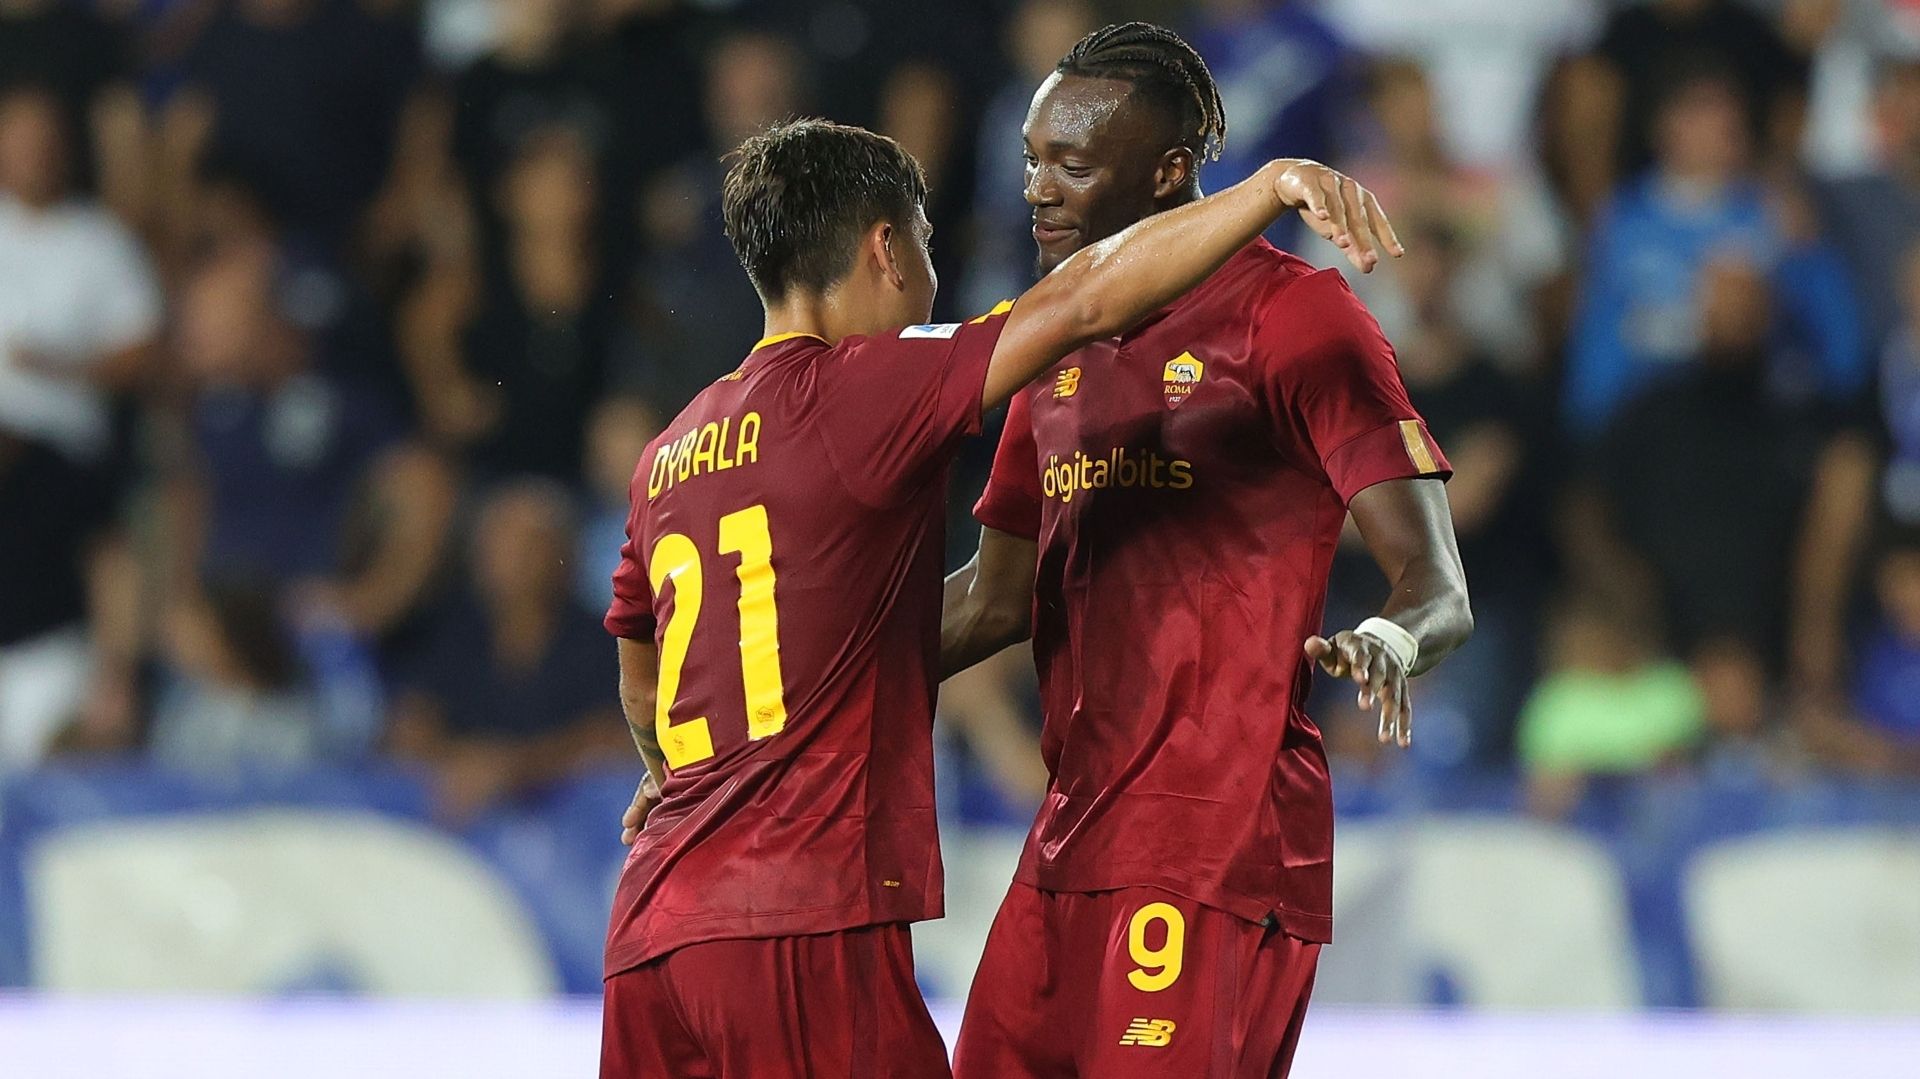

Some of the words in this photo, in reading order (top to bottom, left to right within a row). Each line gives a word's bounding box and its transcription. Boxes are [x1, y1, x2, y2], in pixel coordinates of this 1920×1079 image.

[1164, 384, 1192, 394] ROMA
[648, 411, 761, 500] DYBALA
[1043, 447, 1194, 503] digitalbits
[649, 504, 789, 770] 21
[1127, 902, 1186, 993] 9
